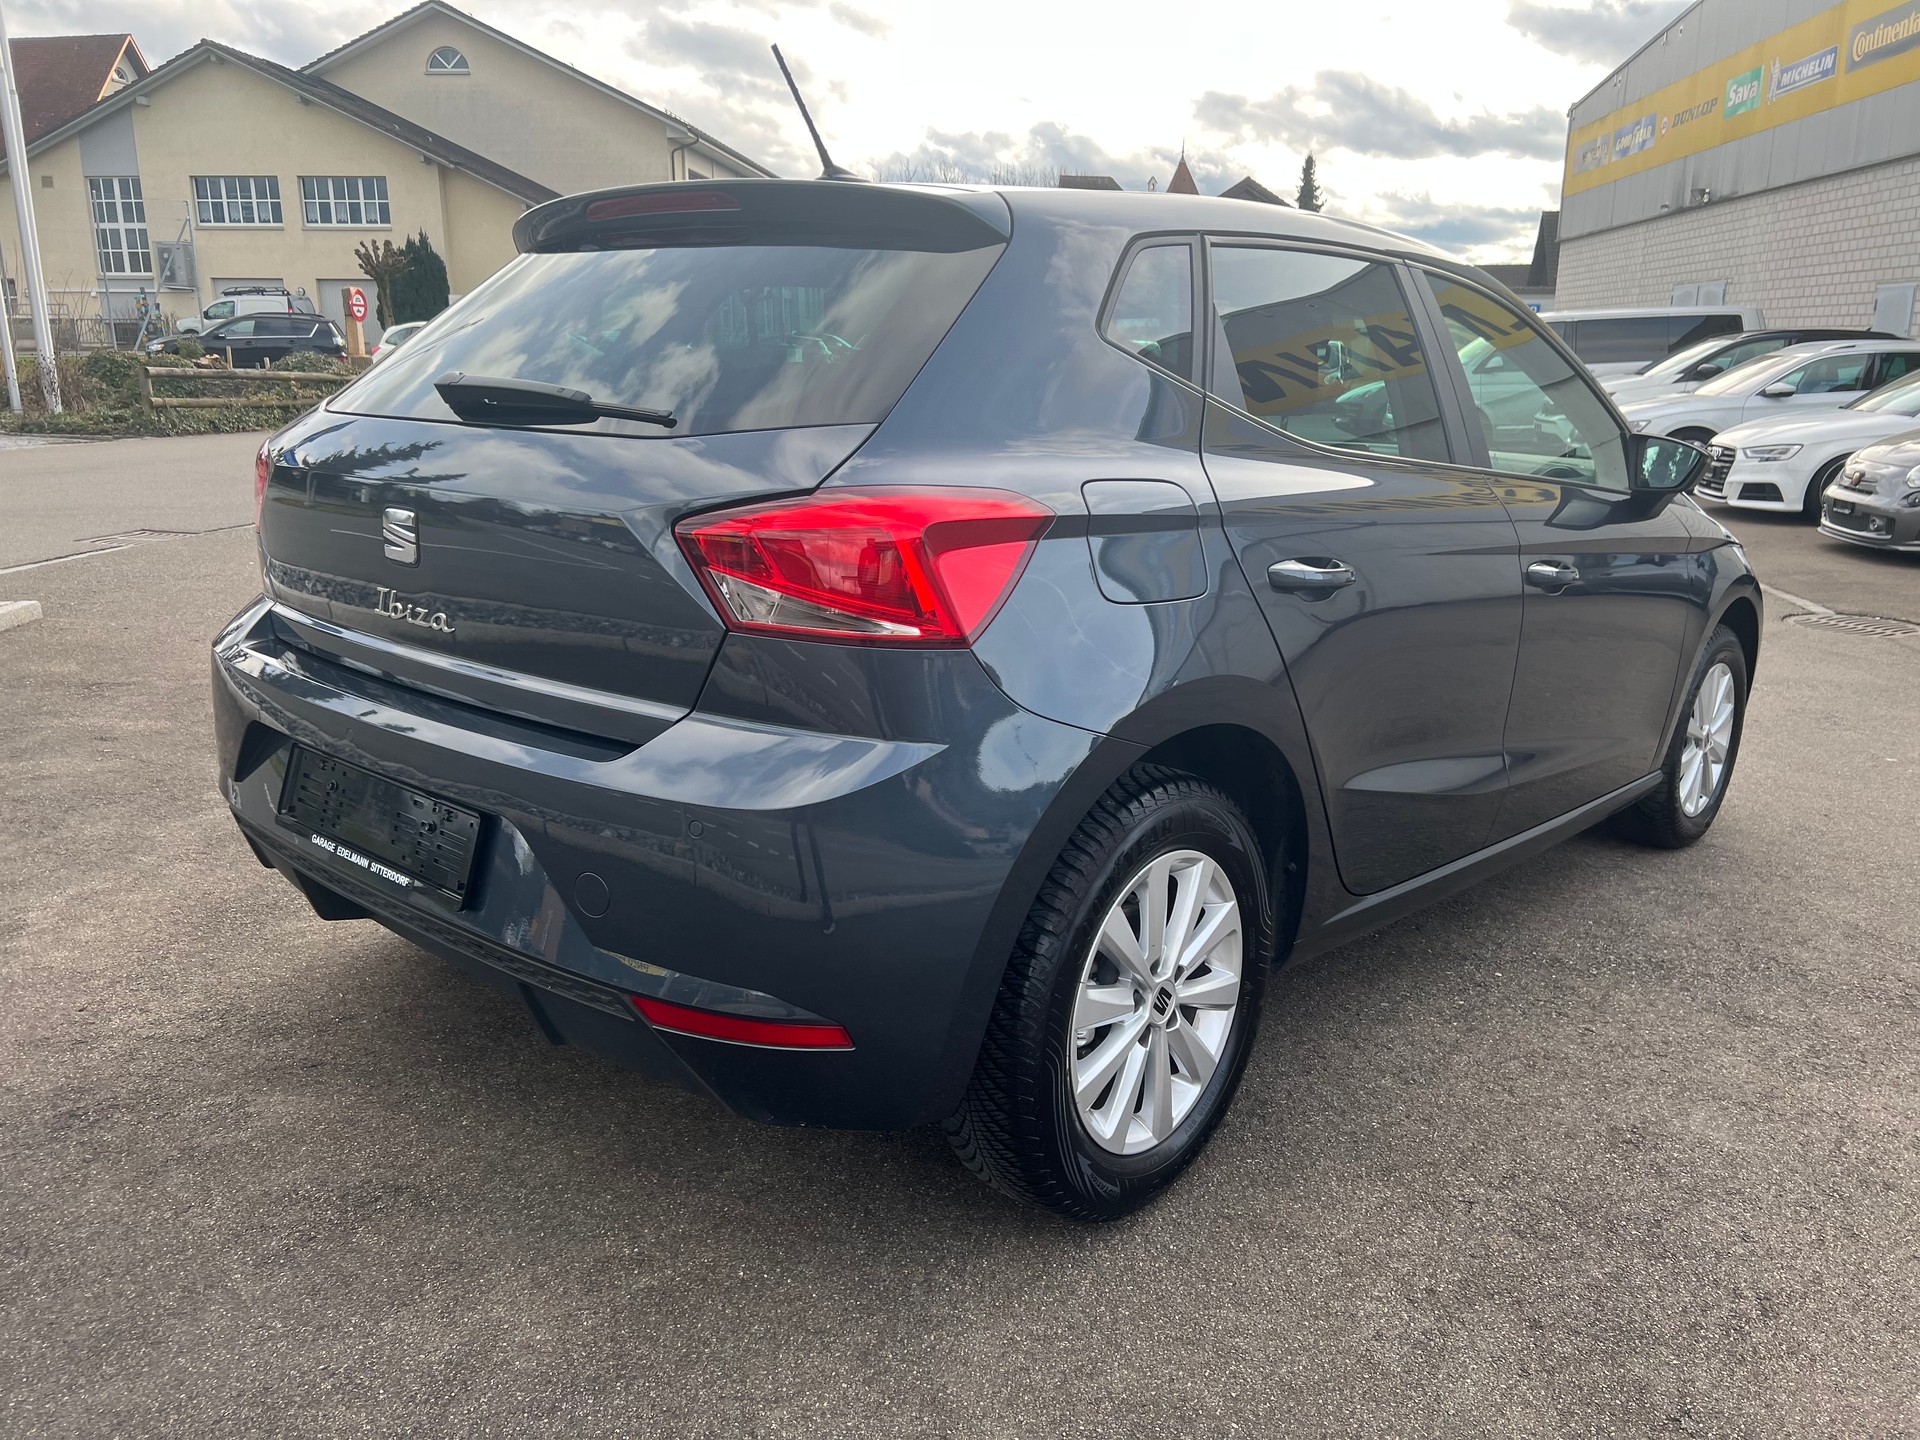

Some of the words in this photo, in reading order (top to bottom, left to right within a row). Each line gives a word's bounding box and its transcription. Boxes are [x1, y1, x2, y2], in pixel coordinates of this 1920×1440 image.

[1781, 53, 1835, 87] MICHELIN
[1728, 80, 1759, 108] Sava
[1672, 97, 1719, 128] DUNLOP
[374, 586, 456, 633] Ibiza
[311, 833, 336, 853] GARAGE
[336, 845, 370, 869] EDELMANN
[370, 861, 410, 887] SITTERDORF
